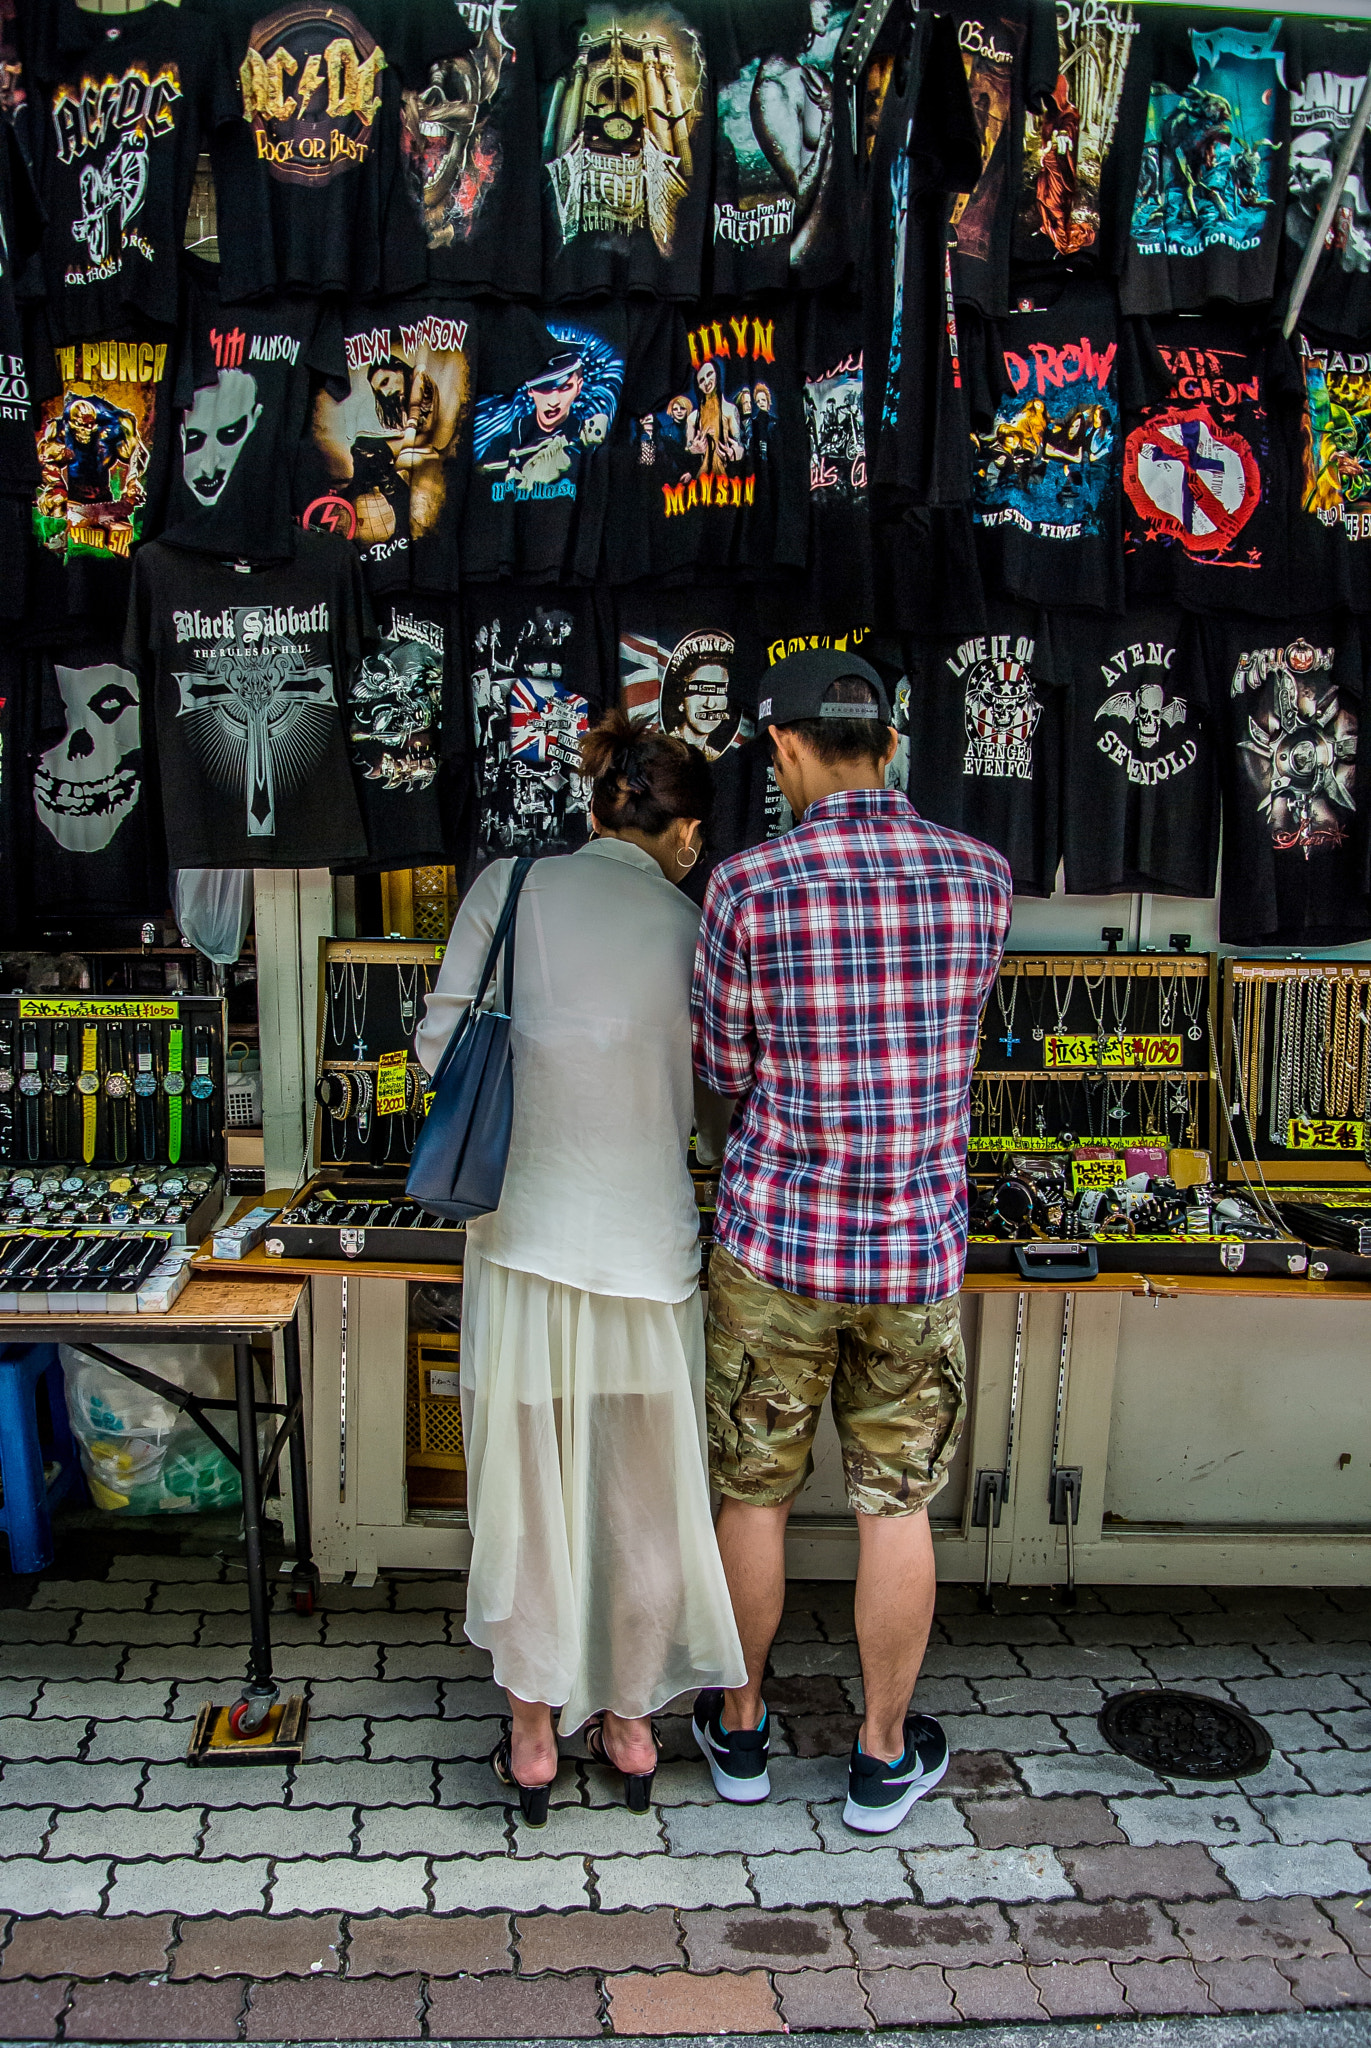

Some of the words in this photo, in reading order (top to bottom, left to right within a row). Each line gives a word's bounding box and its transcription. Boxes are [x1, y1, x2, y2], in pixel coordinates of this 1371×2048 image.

[299, 138, 326, 158] OR
[1137, 242, 1161, 255] THE
[1205, 232, 1226, 247] FOR
[82, 340, 168, 383] PUNCH
[70, 526, 104, 548] YOUR
[1039, 522, 1082, 540] TIME
[172, 609, 236, 644] Black
[242, 602, 330, 644] Sabbath
[193, 648, 217, 658] THE
[219, 647, 259, 658] RULES
[261, 647, 278, 656] OF
[281, 643, 311, 655] HELL
[945, 636, 987, 678] LOVE
[991, 635, 1011, 660] IT
